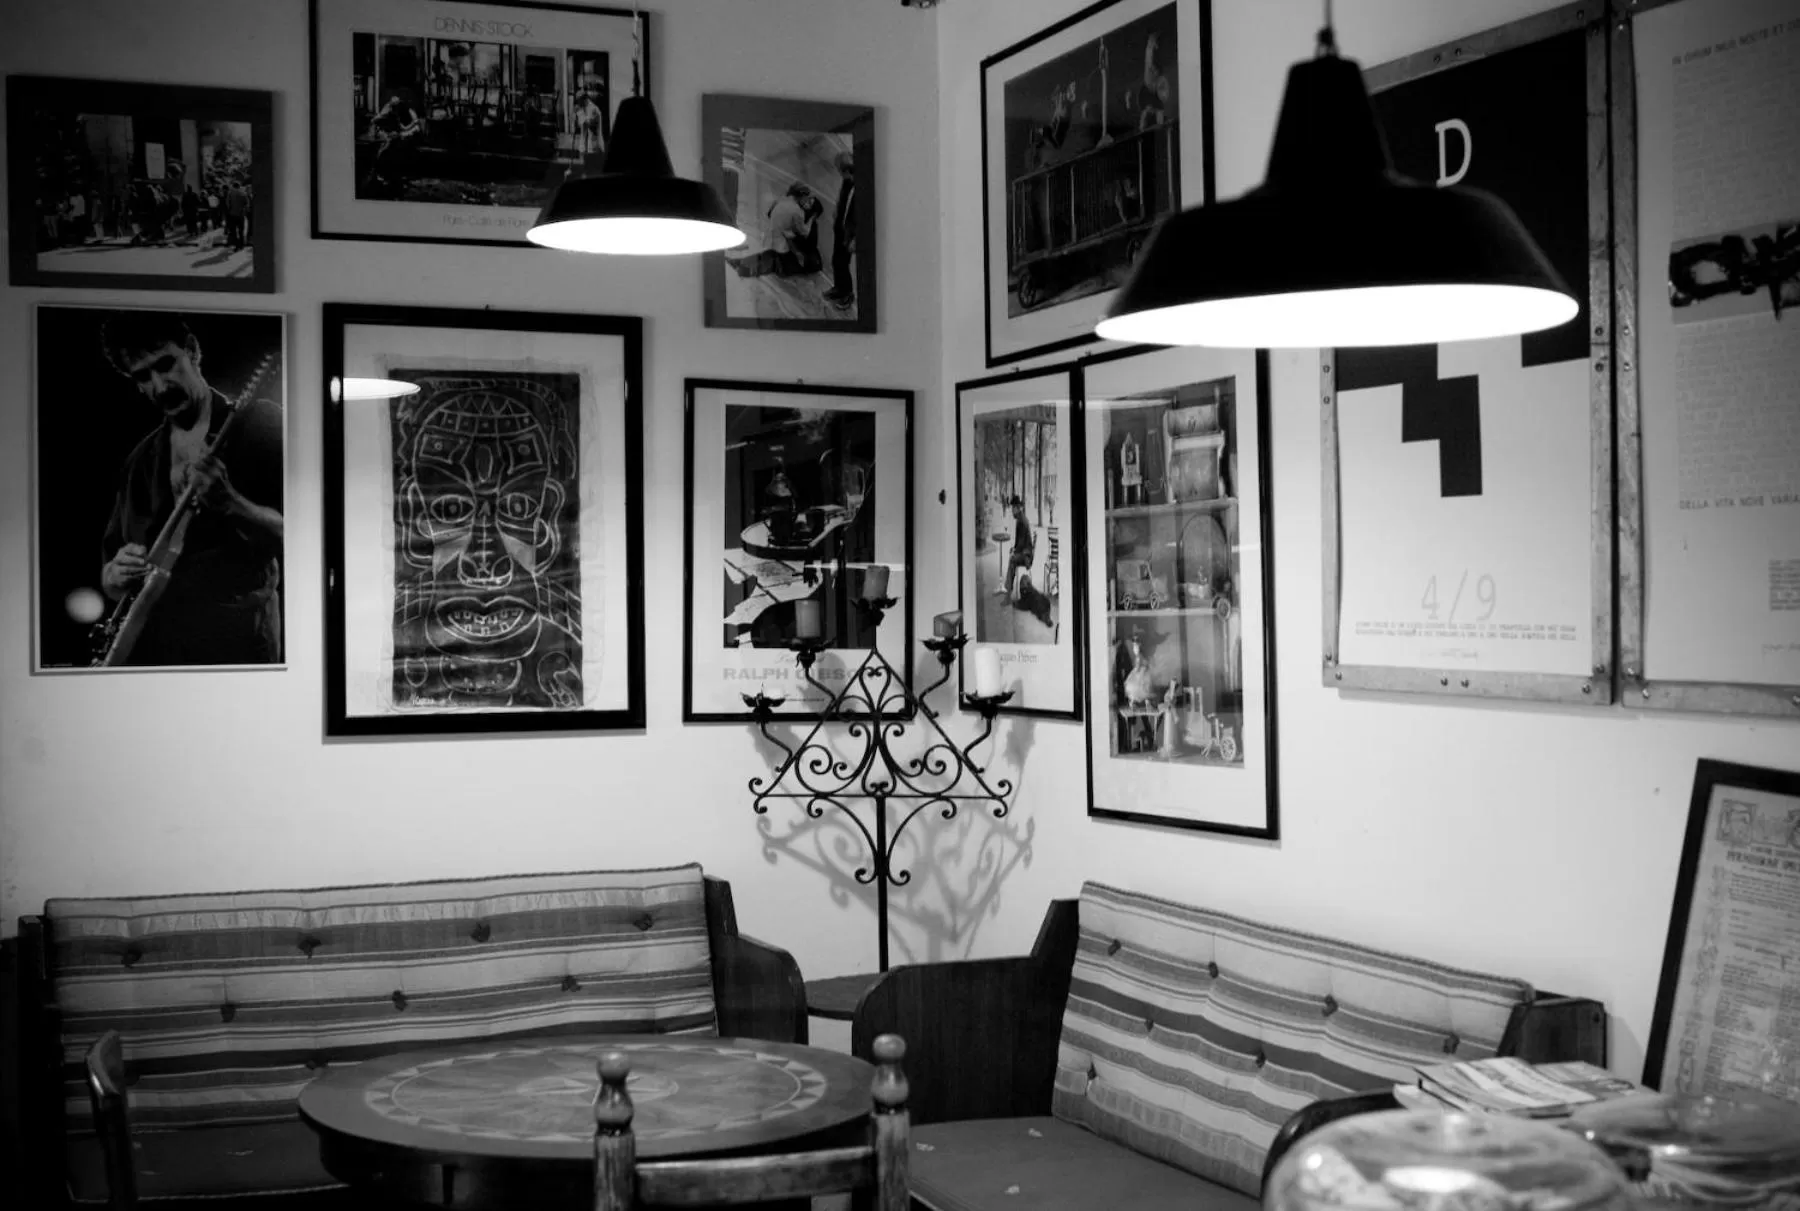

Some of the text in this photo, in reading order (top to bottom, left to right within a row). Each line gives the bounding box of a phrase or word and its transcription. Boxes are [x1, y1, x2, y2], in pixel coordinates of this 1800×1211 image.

[434, 16, 535, 38] DENNIS STOCK
[1434, 117, 1473, 188] D
[1421, 568, 1497, 623] 4/9
[722, 667, 789, 680] RALPH
